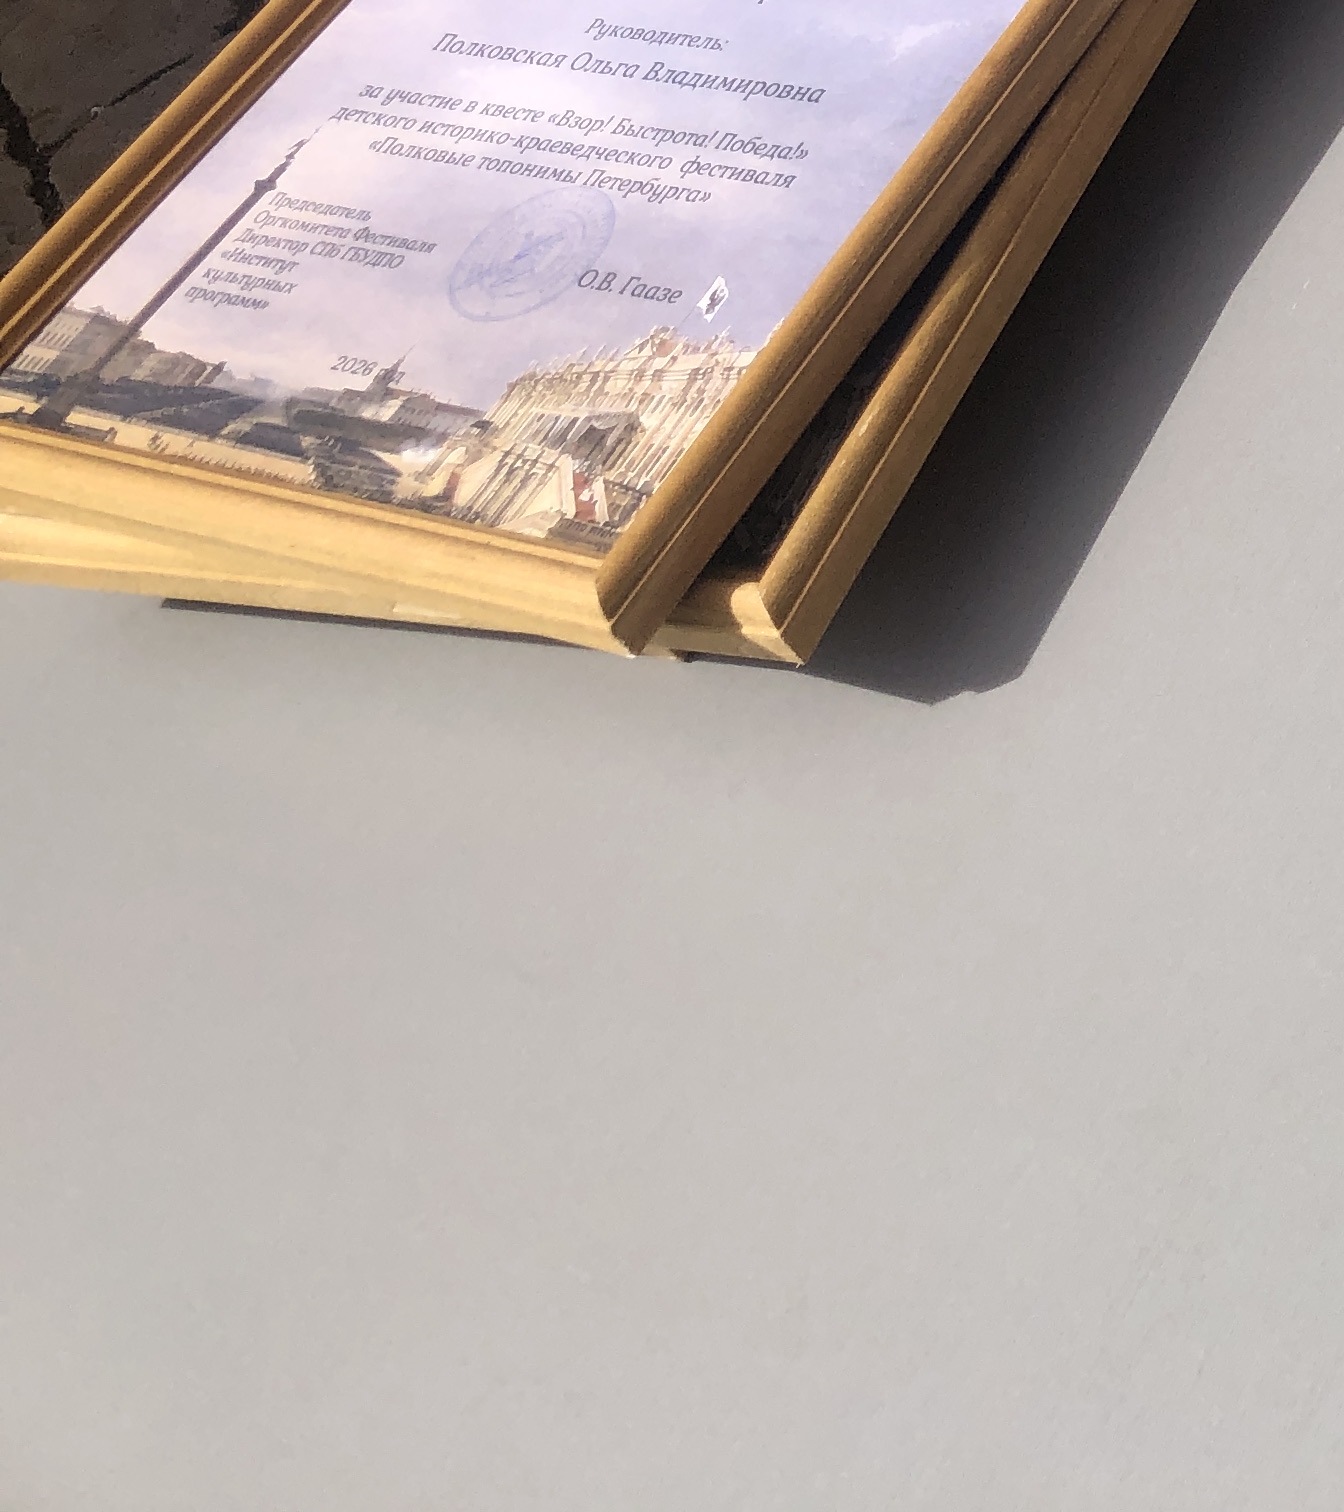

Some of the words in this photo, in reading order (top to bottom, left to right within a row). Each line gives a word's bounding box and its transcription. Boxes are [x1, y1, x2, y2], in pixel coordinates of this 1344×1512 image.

[584, 18, 729, 52] Руководитель:
[433, 33, 568, 69] Полковская
[570, 52, 640, 80] Ольга
[642, 61, 826, 104] Владимировна
[359, 84, 384, 98] за
[381, 89, 463, 110] участие
[463, 101, 478, 113] в
[479, 103, 545, 123] квесте
[548, 109, 615, 136] «Взор!
[610, 117, 719, 148] Быстрота!
[715, 131, 809, 160] Победа!»
[328, 106, 418, 130] детского
[417, 120, 673, 170] историко-краеведческого
[680, 155, 797, 189] фестиваля
[369, 136, 476, 167] «Полковые
[476, 156, 583, 185] топонимы
[583, 168, 711, 204] Петербурга»
[269, 192, 371, 222] Председатель
[233, 228, 309, 256] Директор
[309, 241, 342, 259] СПб
[341, 246, 406, 270] ГБУДПО
[254, 210, 351, 239] Оргкомитета
[352, 226, 438, 254] Фестиваля
[221, 248, 300, 275] «Институт
[202, 268, 298, 295] культурных
[578, 269, 612, 292] О.В.
[618, 276, 683, 304] Гаазе
[330, 356, 378, 376] 2026
